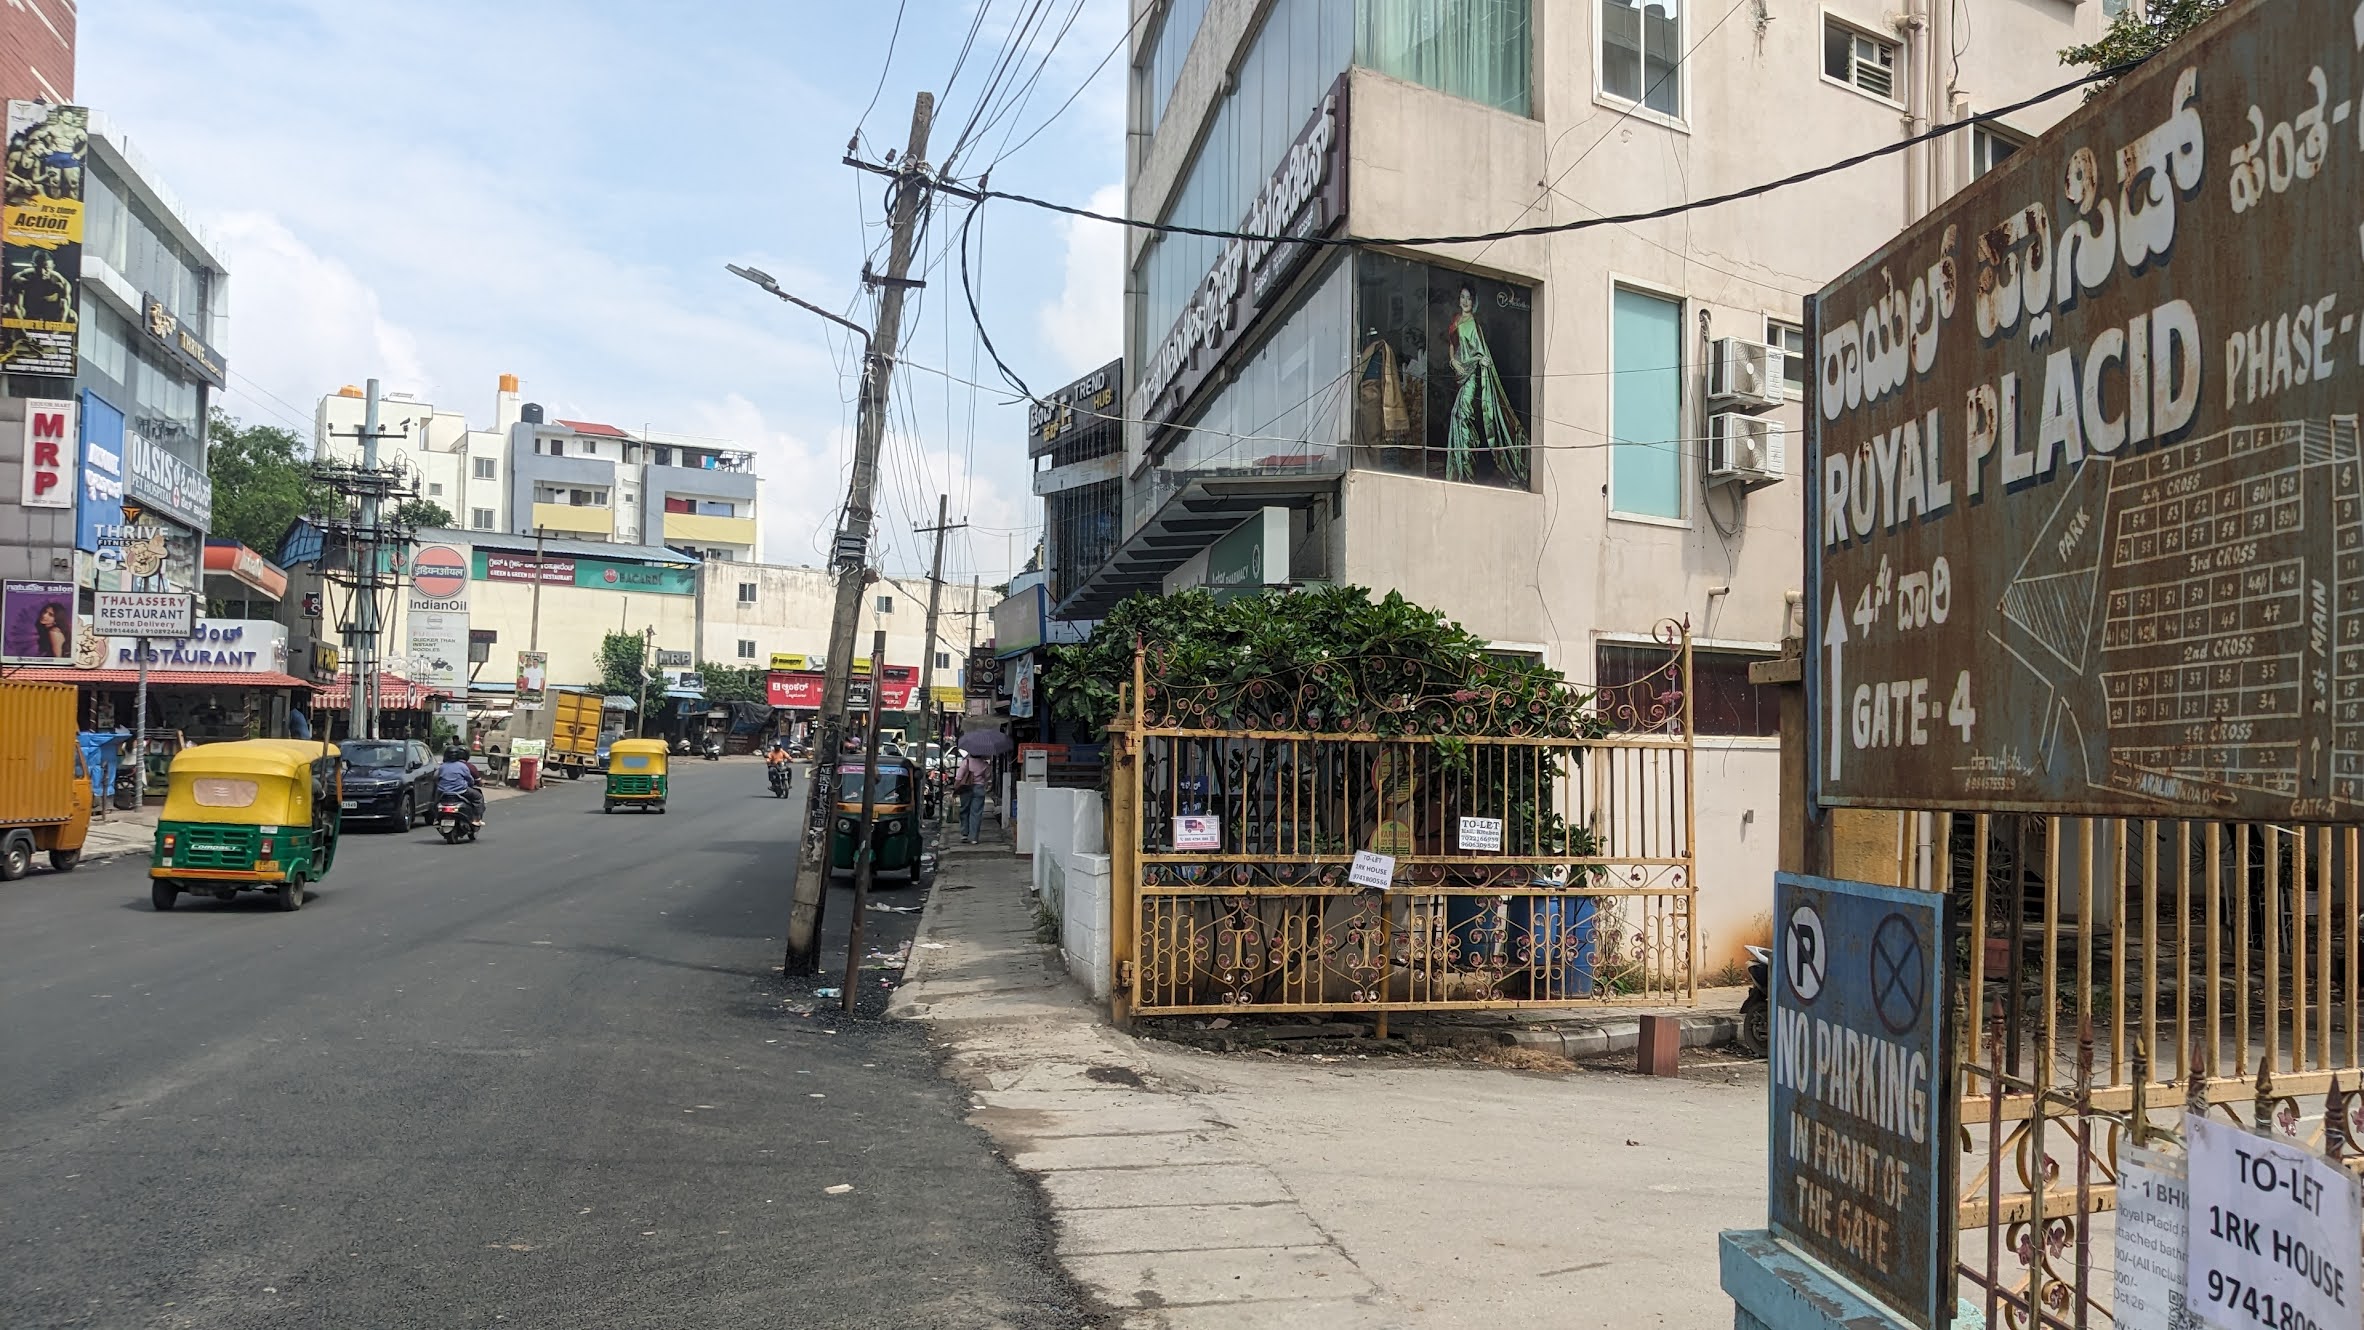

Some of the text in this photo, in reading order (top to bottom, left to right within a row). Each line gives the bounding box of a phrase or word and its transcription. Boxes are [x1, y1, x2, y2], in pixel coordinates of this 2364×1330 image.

[14, 213, 68, 230] Action
[1074, 372, 1105, 401] TREND
[1094, 389, 1112, 409] HUB
[1825, 299, 2201, 547] ROYAL PLACID
[133, 434, 173, 491] OASIS
[2161, 455, 2170, 470] 2
[2236, 436, 2245, 449] 4
[145, 478, 172, 504] HOSPITAL
[2166, 474, 2200, 497] CROSS
[93, 524, 169, 540] THRIVE
[2058, 510, 2090, 562] PARK
[2191, 527, 2205, 542] 57
[2190, 543, 2258, 573] 3rd CROSS
[543, 573, 573, 581] RESTAURANT
[101, 595, 186, 607] THALASSERY
[2191, 587, 2203, 601] 50
[101, 608, 185, 620] RESTAURANT
[410, 600, 467, 611] IndianOil
[2263, 604, 2281, 622] 47
[110, 620, 175, 629] Home Delivery
[2310, 579, 2328, 657] MAIN
[2347, 620, 2360, 638] 13
[660, 653, 690, 664] MRP
[2184, 636, 2256, 662] 2nd CROSS
[2218, 668, 2232, 683] 36
[2261, 664, 2277, 678] 35
[2344, 681, 2356, 697] 15
[2213, 698, 2229, 714] 33
[2258, 693, 2277, 710] 34
[2344, 705, 2358, 720] 16
[2210, 723, 2253, 742] CROSS
[2259, 751, 2276, 763] 22
[1462, 820, 1500, 829] TO-LET
[1363, 855, 1382, 863] TO-LET
[1366, 866, 1387, 875] HOUSE
[1777, 1005, 1927, 1144] NO PARKING
[1790, 1111, 1910, 1213] IN FRONT OF
[2235, 1149, 2324, 1217] TO-LET
[1796, 1175, 1890, 1275] THE GATE
[2147, 1213, 2179, 1235] Placid
[2209, 1205, 2346, 1308] 1RK HOUSE
